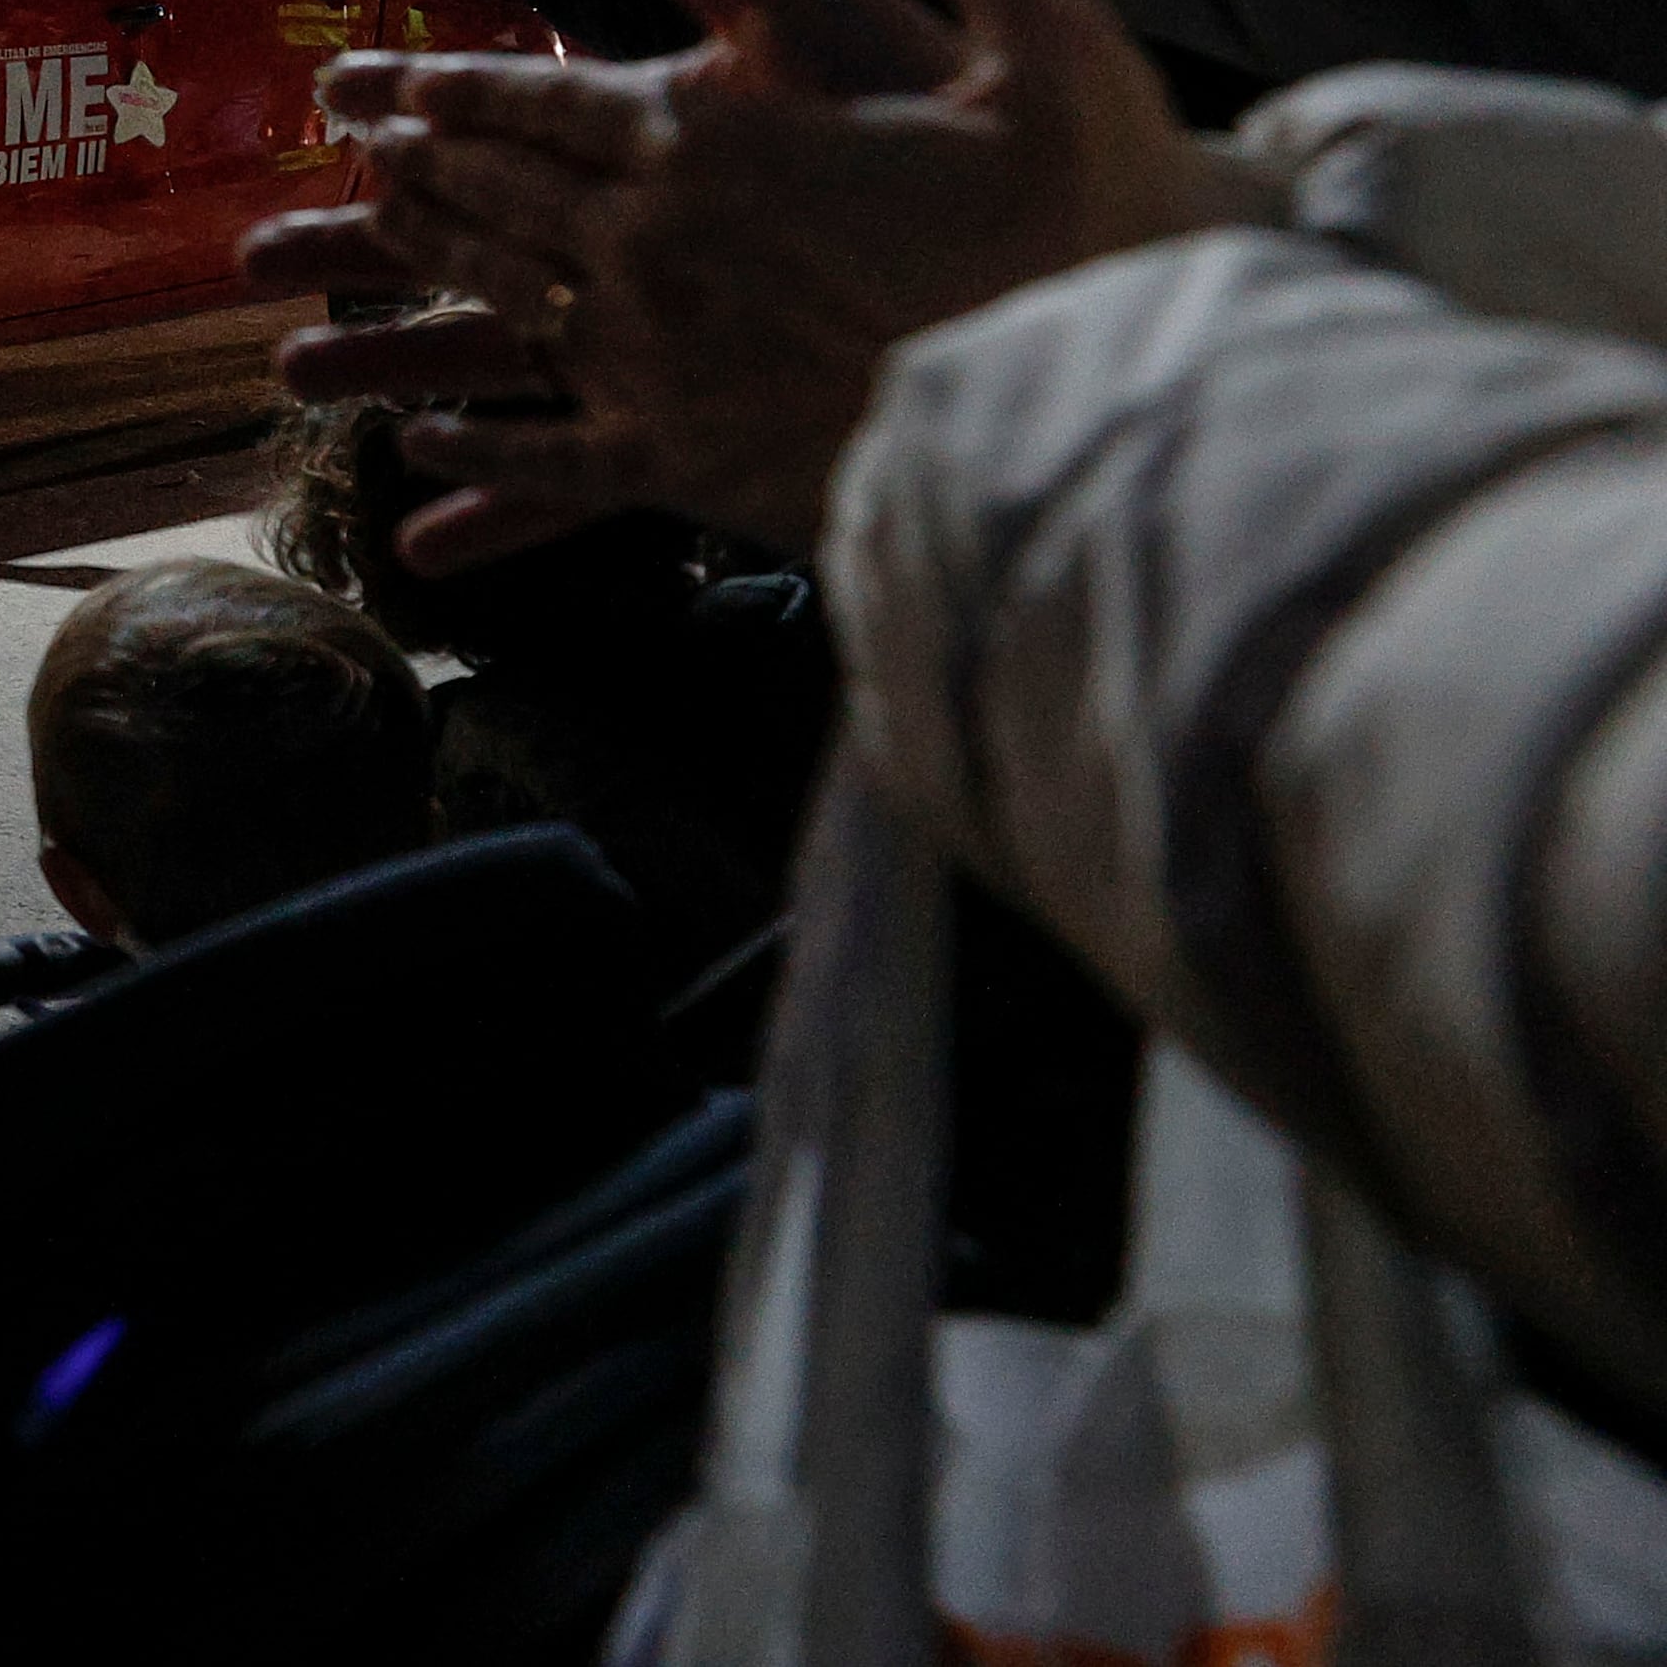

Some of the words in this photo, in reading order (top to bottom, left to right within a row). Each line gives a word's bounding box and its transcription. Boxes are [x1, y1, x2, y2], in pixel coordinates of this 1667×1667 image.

[28, 45, 42, 58] DE
[43, 41, 108, 55] EMERGENCIAS
[76, 138, 107, 177] III
